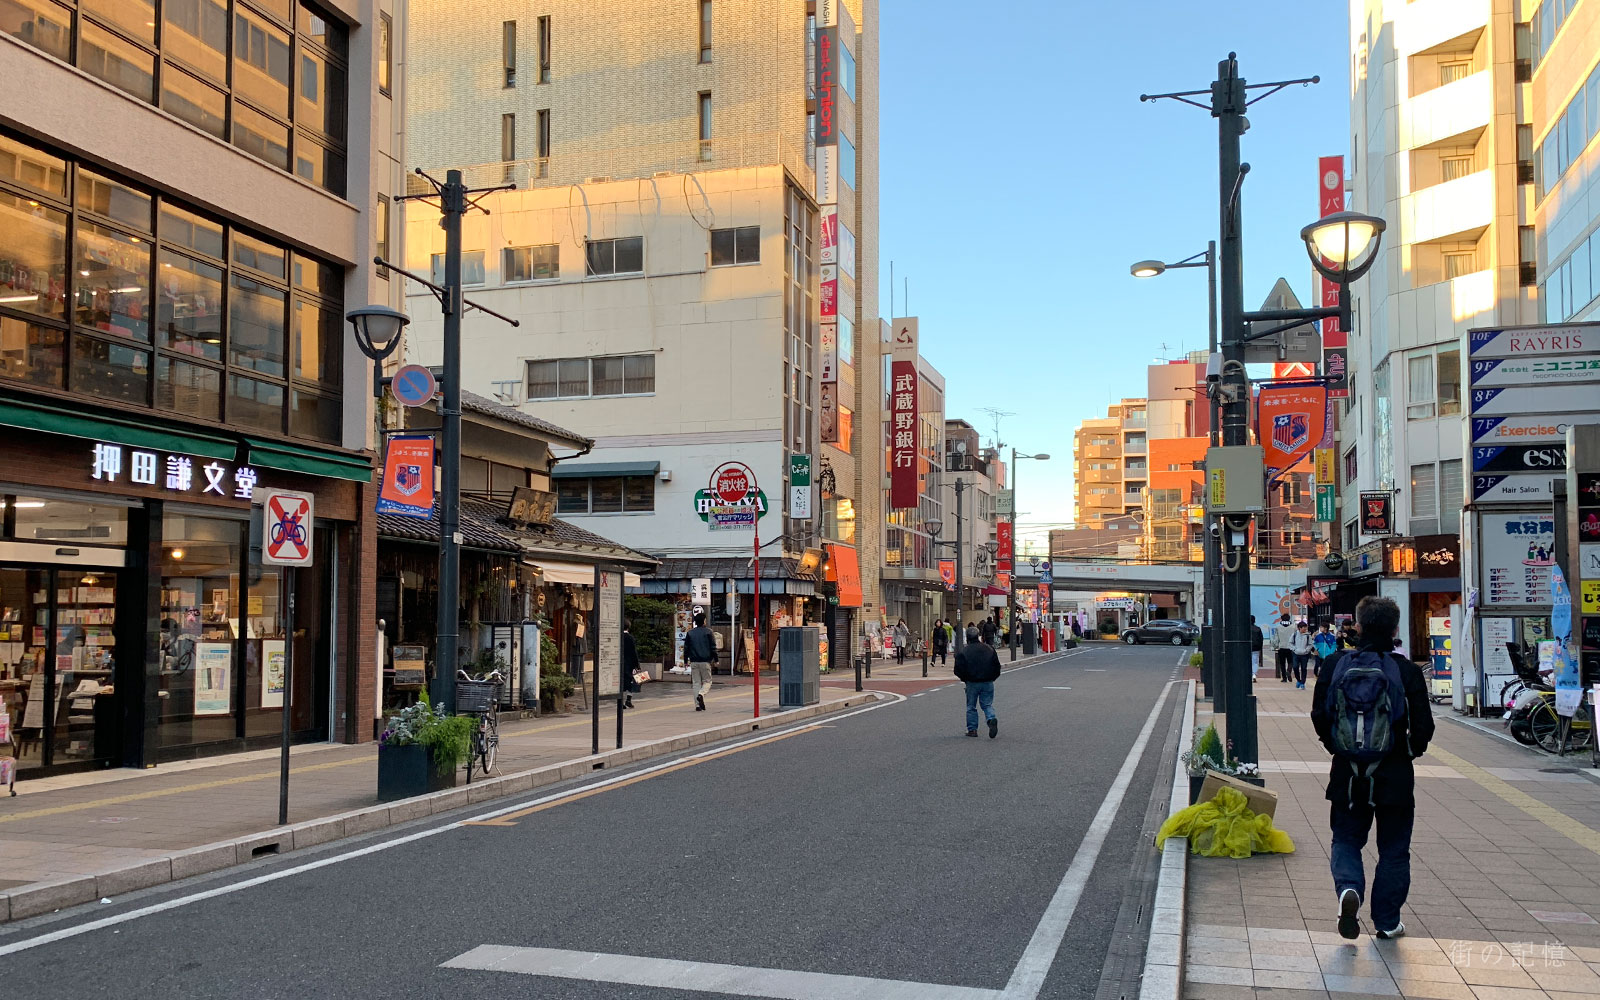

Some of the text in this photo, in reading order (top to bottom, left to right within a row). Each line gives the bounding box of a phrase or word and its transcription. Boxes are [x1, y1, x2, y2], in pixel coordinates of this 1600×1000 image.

[820, 34, 834, 137] disk union
[1471, 332, 1491, 341] 10F
[1510, 335, 1582, 352] RAYRIS
[1475, 361, 1494, 372] 9F
[1475, 390, 1494, 402] 8F
[895, 374, 915, 468] 武蔵野銀行
[1477, 419, 1494, 431] 7F
[1477, 448, 1496, 459] 5F
[92, 443, 257, 499] 押田謙文堂
[719, 478, 746, 493] 消火栓
[1476, 477, 1496, 489] 2F
[1520, 486, 1540, 494] Salon
